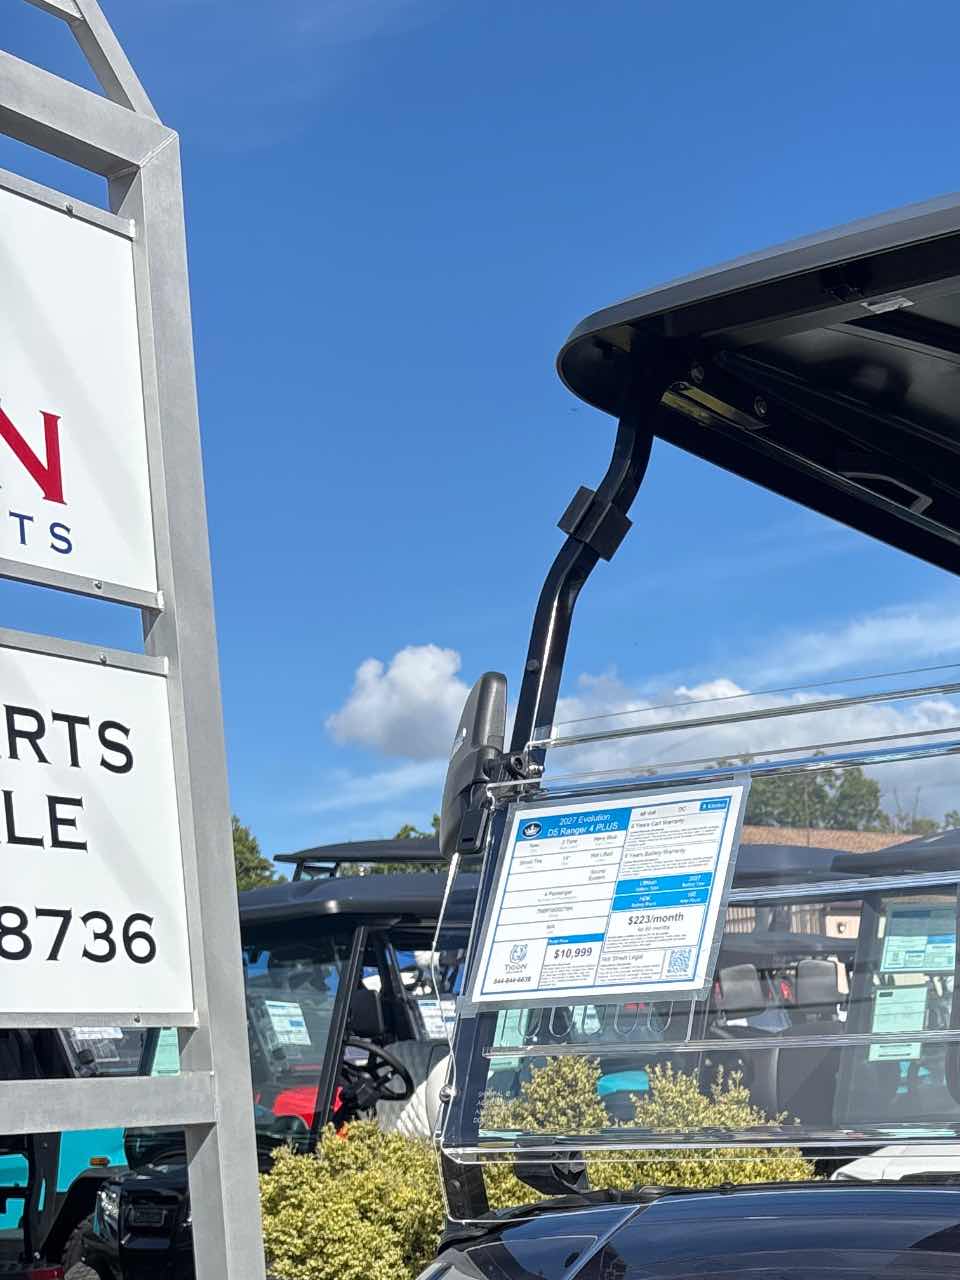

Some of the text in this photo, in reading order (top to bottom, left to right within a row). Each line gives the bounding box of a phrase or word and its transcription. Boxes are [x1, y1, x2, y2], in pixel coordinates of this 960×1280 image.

[0, 704, 134, 774] RTS
[0, 789, 88, 853] LE
[560, 813, 611, 826] 2027 Evolution
[547, 828, 559, 837] D5
[560, 825, 588, 837] Ranger
[596, 821, 619, 831] PLUS
[627, 911, 684, 926] $223/month
[0, 905, 157, 964] 8736
[554, 947, 593, 959] $10,999
